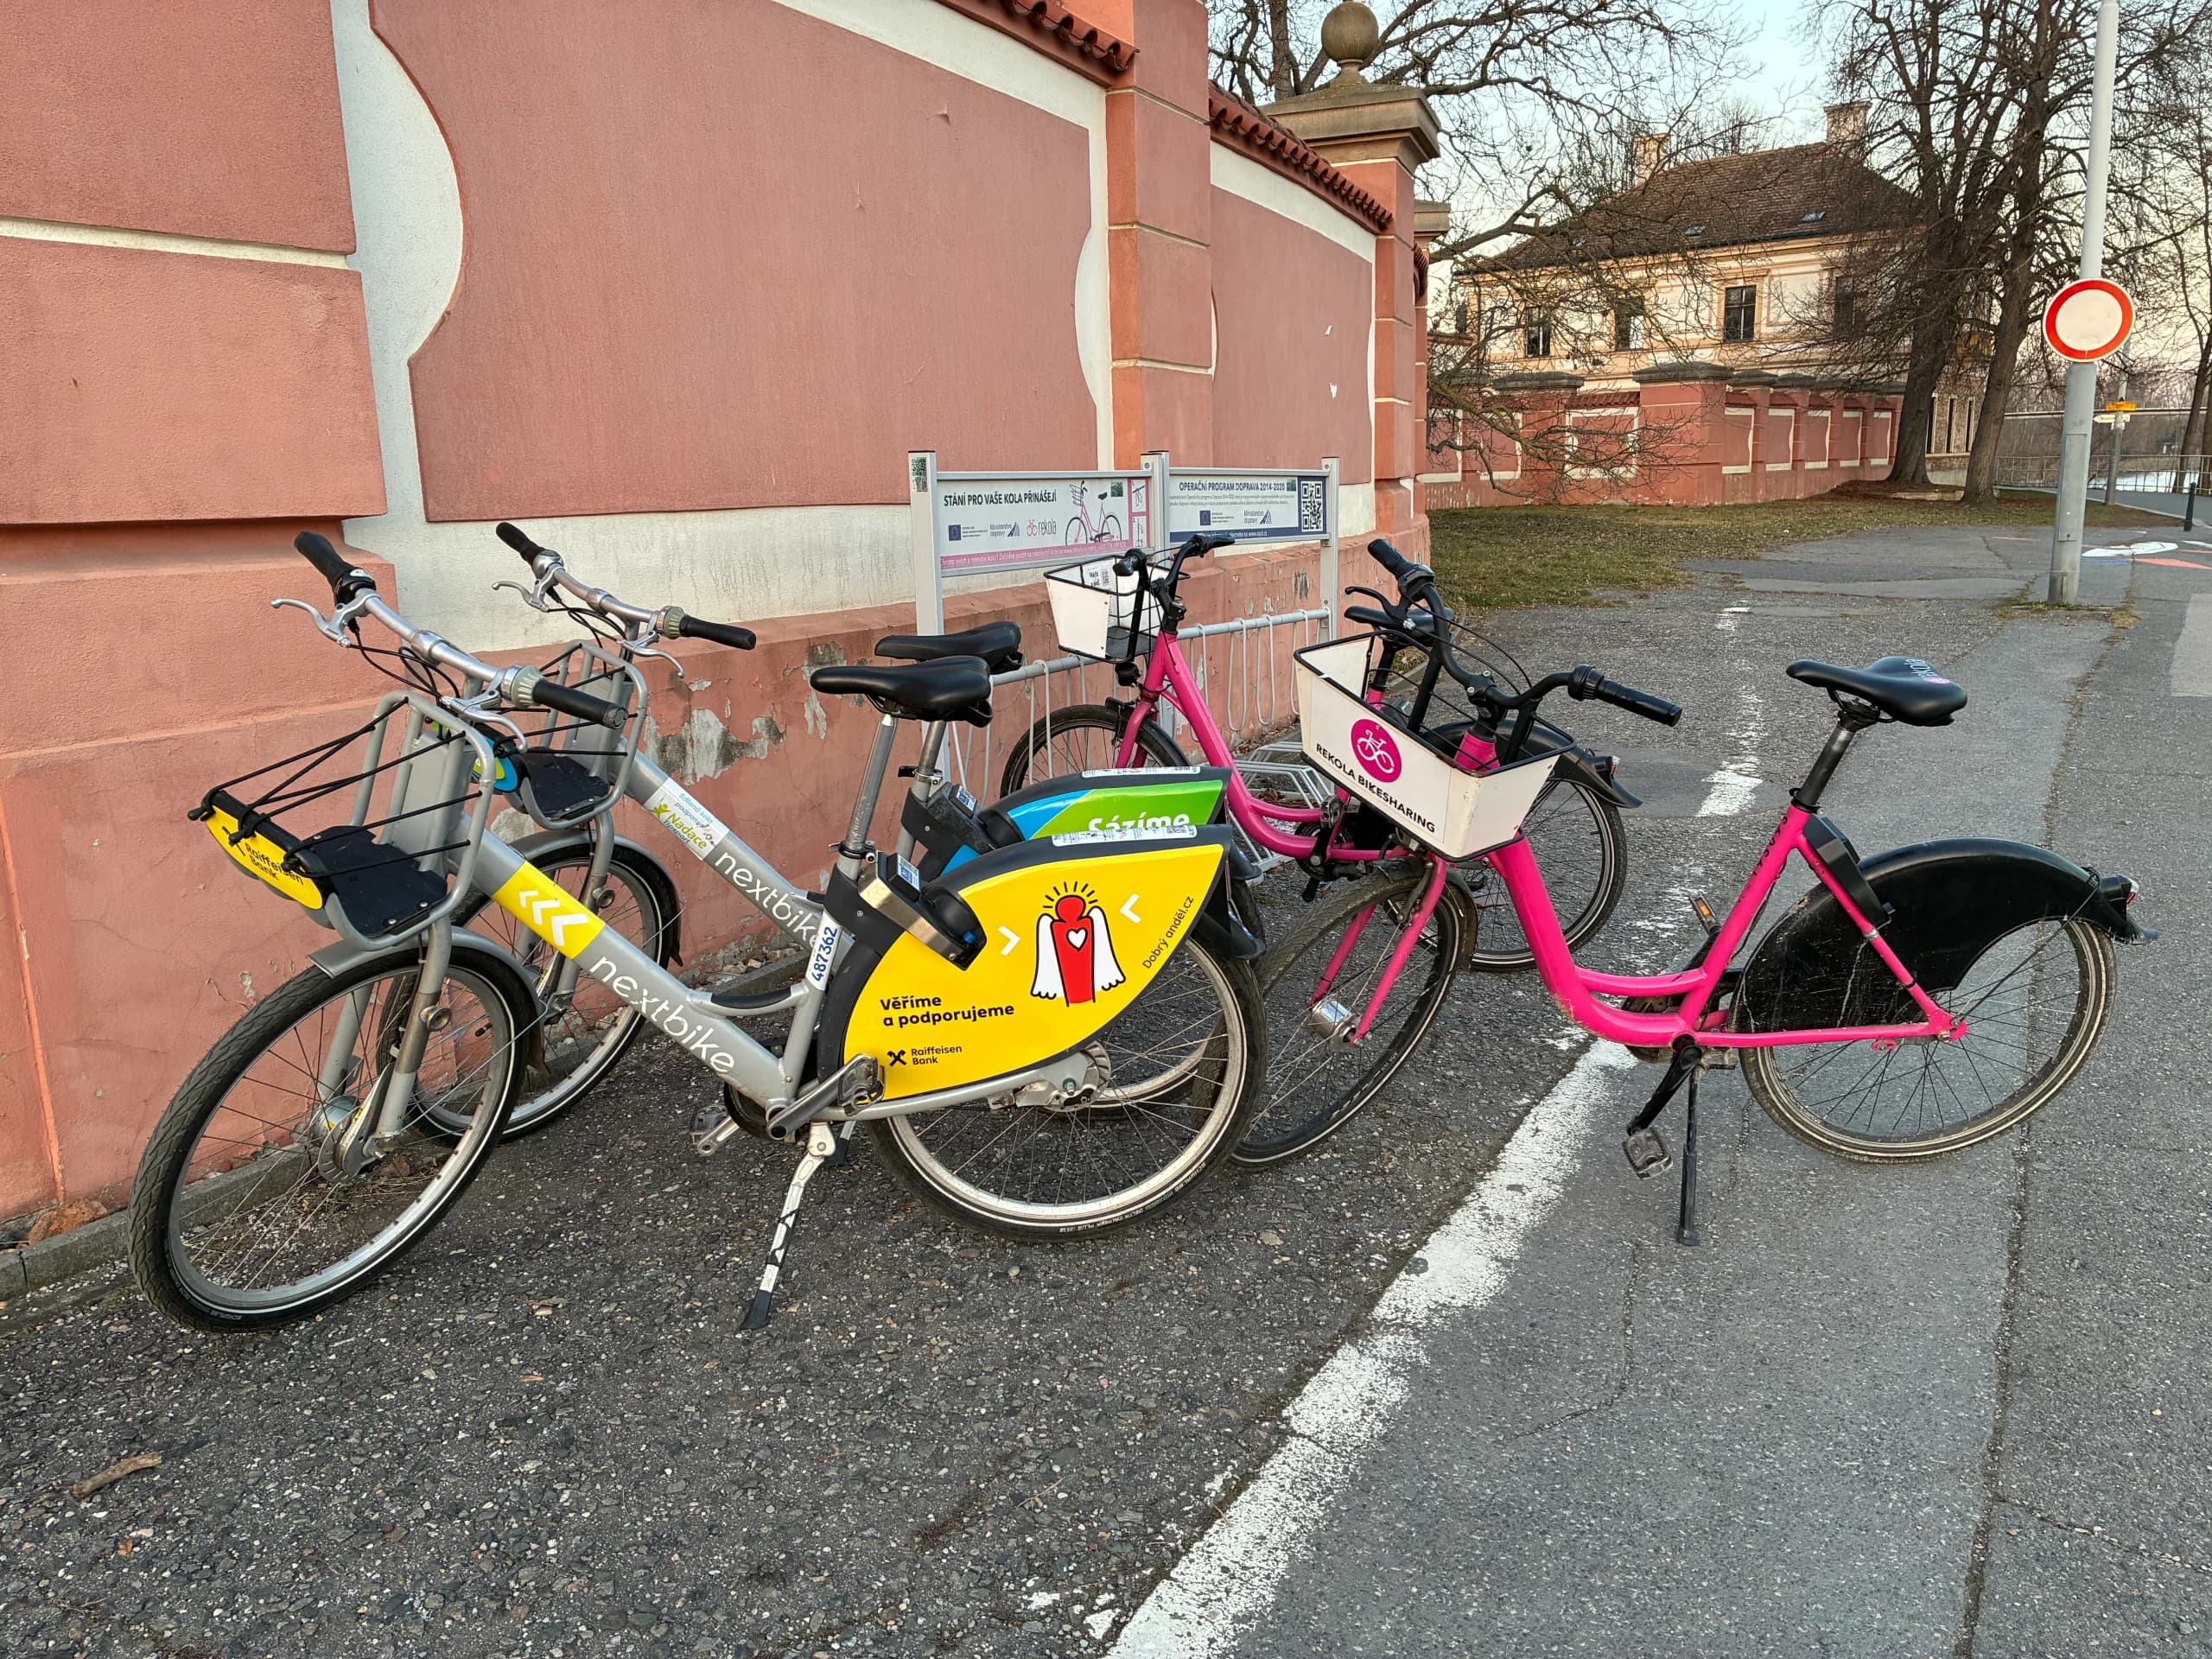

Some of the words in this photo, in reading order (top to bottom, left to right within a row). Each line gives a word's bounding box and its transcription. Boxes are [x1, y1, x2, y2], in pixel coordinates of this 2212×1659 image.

[1179, 480, 1208, 492] OPERAČNÍ
[1208, 482, 1235, 492] PROGRAM
[1236, 482, 1260, 492] DOPRAVA
[1260, 482, 1286, 492] 2014-2020
[944, 492, 966, 506] STÁNÍ
[968, 494, 983, 505] PRO
[984, 491, 1002, 505] VAŠE
[1004, 493, 1023, 504] KOLA
[1023, 489, 1057, 503] PŘINÁŠEJÍ
[1038, 518, 1057, 536] rekola
[1316, 743, 1356, 779] REKOLA
[1357, 775, 1435, 833] BIKESHARING
[668, 813, 707, 849] Nadace
[1088, 811, 1190, 832] Sázíme
[249, 854, 279, 880] Bank
[1142, 938, 1168, 969] Dobrý
[1166, 896, 1194, 938] anděl.cz
[812, 926, 838, 982] 487362
[880, 995, 942, 1010] Věříme
[589, 957, 734, 1072] nextbike
[883, 1016, 893, 1027] a
[899, 1005, 1014, 1028] podporujeme
[911, 1046, 963, 1056] Raiffeisen
[912, 1056, 938, 1065] Bank
